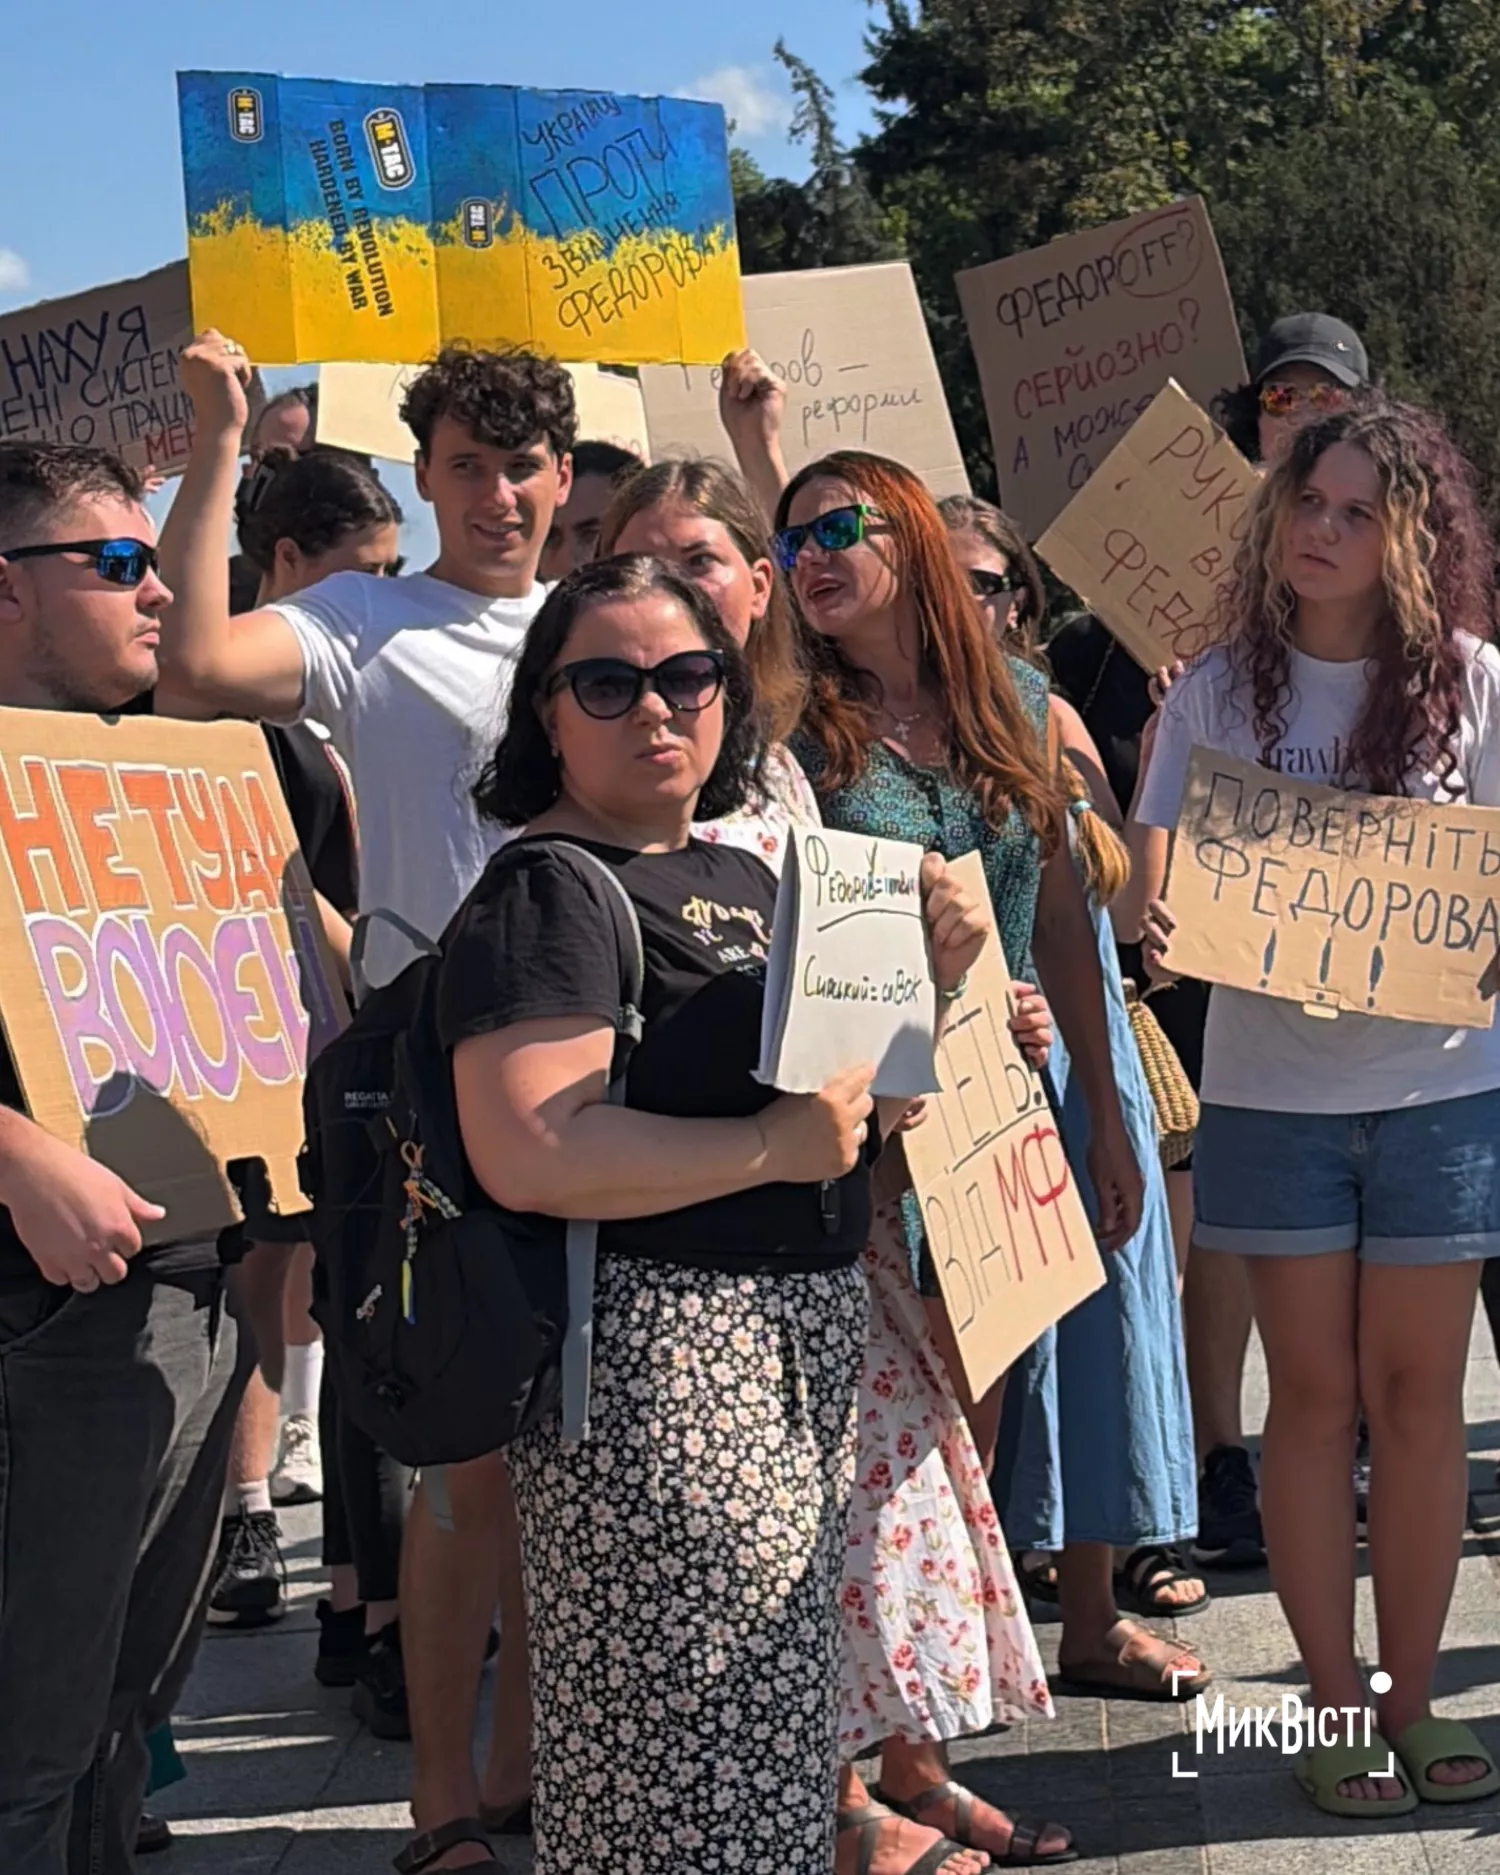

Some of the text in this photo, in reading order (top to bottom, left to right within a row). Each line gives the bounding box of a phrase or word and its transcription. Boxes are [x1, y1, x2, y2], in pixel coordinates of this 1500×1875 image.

[309, 139, 368, 310] HARDENED BY WAR
[329, 117, 394, 318] BORN BY REVOLUTION
[529, 128, 678, 241] ПРОТИ
[0, 384, 64, 435] ЕНІ
[1195, 837, 1500, 953] ФЕДОРОВА
